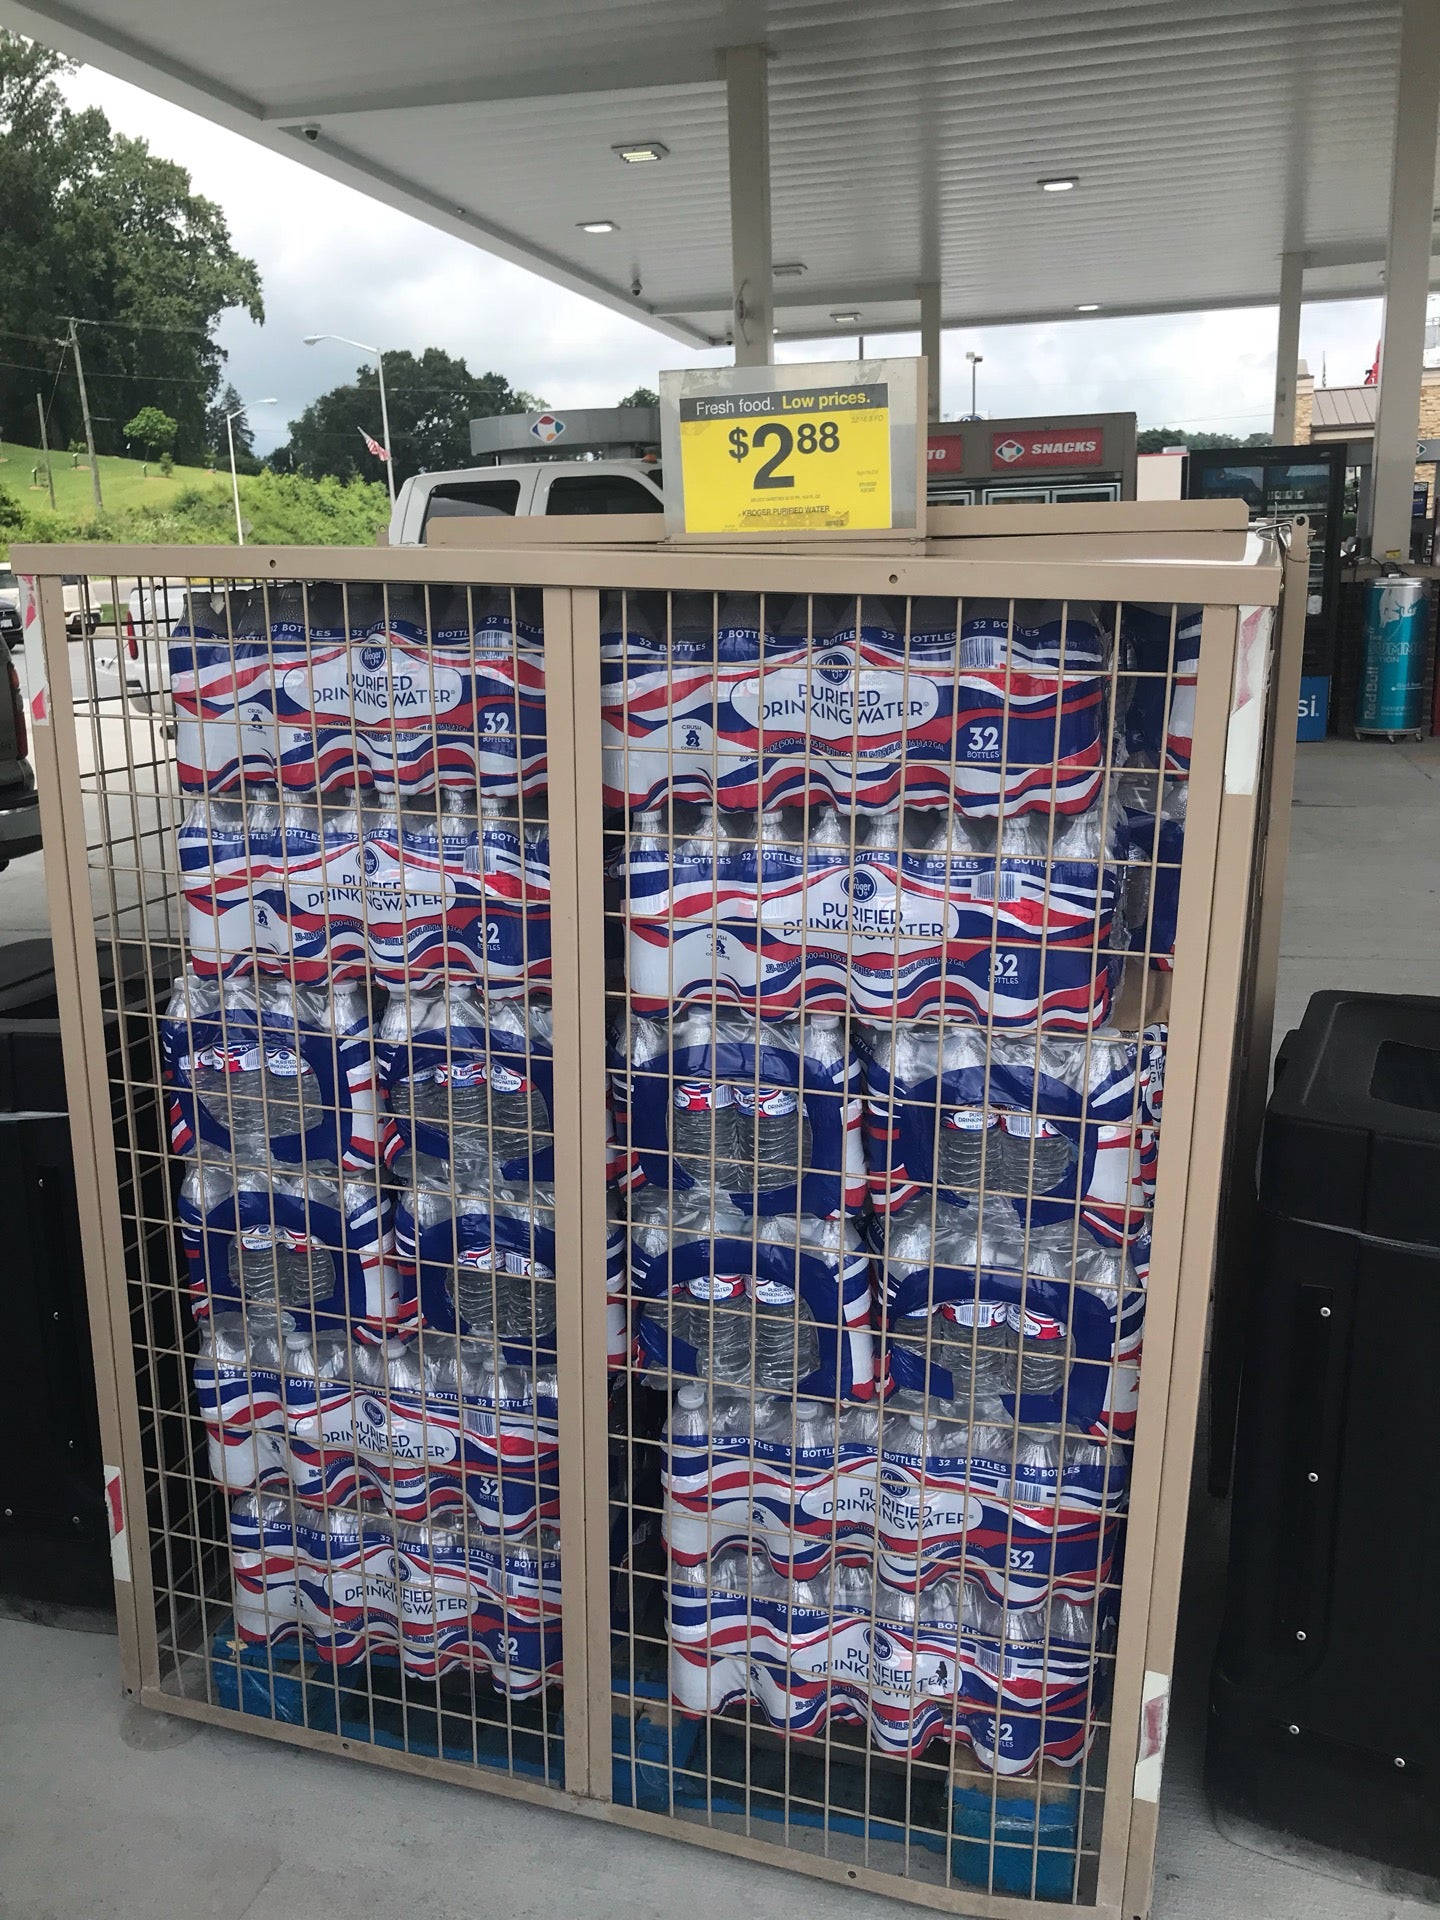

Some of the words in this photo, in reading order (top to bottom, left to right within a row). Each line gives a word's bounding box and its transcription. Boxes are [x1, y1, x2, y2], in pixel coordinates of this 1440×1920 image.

[696, 400, 735, 416] Fresh
[739, 396, 775, 412] food.
[782, 394, 814, 410] Low
[818, 391, 870, 408] prices.
[1031, 441, 1096, 454] SNACKS
[805, 505, 830, 514] WATER
[352, 629, 363, 637] 32
[438, 628, 476, 638] BOTTL
[504, 619, 544, 635] BTTLE
[640, 638, 652, 648] 32
[659, 643, 706, 651] BOTTLES
[881, 631, 895, 641] 32
[973, 620, 986, 629] 32
[994, 621, 1039, 638] BOTLES
[347, 673, 412, 691] PURIFIED
[798, 684, 880, 708] PURIFIED
[484, 712, 510, 734] 32
[968, 727, 998, 750] 32
[967, 750, 999, 759] BOTTLES
[212, 832, 225, 840] 32
[280, 828, 322, 841] OTTLES
[347, 833, 358, 841] 32
[406, 834, 422, 843] 32
[429, 837, 468, 845] BOTTLES
[491, 832, 537, 849] BOTTES
[683, 857, 731, 865] BOTTLES
[742, 853, 751, 861] 32
[757, 852, 802, 864] OTTLES
[827, 857, 842, 865] 32
[851, 853, 890, 863] OTTLES
[907, 857, 919, 867] 32
[926, 861, 979, 869] BOTLES
[1014, 858, 1056, 869] BOTTLS
[849, 877, 872, 897] roger
[823, 903, 903, 925] PURIFIED
[477, 921, 500, 944] 32
[989, 953, 1018, 977] 32
[290, 1379, 334, 1388] BOTTES
[428, 1391, 467, 1403] BOTTLS
[731, 1437, 774, 1451] BOTTLES
[785, 1448, 795, 1457] 3
[803, 1446, 845, 1458] BOTTLS
[866, 1446, 878, 1454] 32
[884, 1453, 922, 1467] BOTTLES
[938, 1459, 950, 1467] 32
[957, 1458, 1006, 1472] BOTTLES
[1023, 1468, 1035, 1476] 32
[1041, 1467, 1080, 1477] BOTLES
[479, 1493, 504, 1502] BOTTL
[480, 1477, 502, 1496] 32
[273, 1522, 307, 1535] BOTLES
[320, 1534, 361, 1543] BOTTLES
[394, 1539, 421, 1553] TTLES
[514, 1560, 556, 1569] BOTTES
[1009, 1551, 1034, 1569] 32
[376, 1573, 434, 1604] PUIFIED
[345, 1587, 413, 1613] DRINKIG
[726, 1592, 769, 1604] BOTLES
[777, 1603, 786, 1613] 32
[792, 1608, 831, 1617] BOTTLE
[853, 1607, 865, 1615] 32
[497, 1633, 518, 1656] 32
[986, 1717, 1013, 1740] 32
[985, 1735, 1014, 1748] BOTLES
